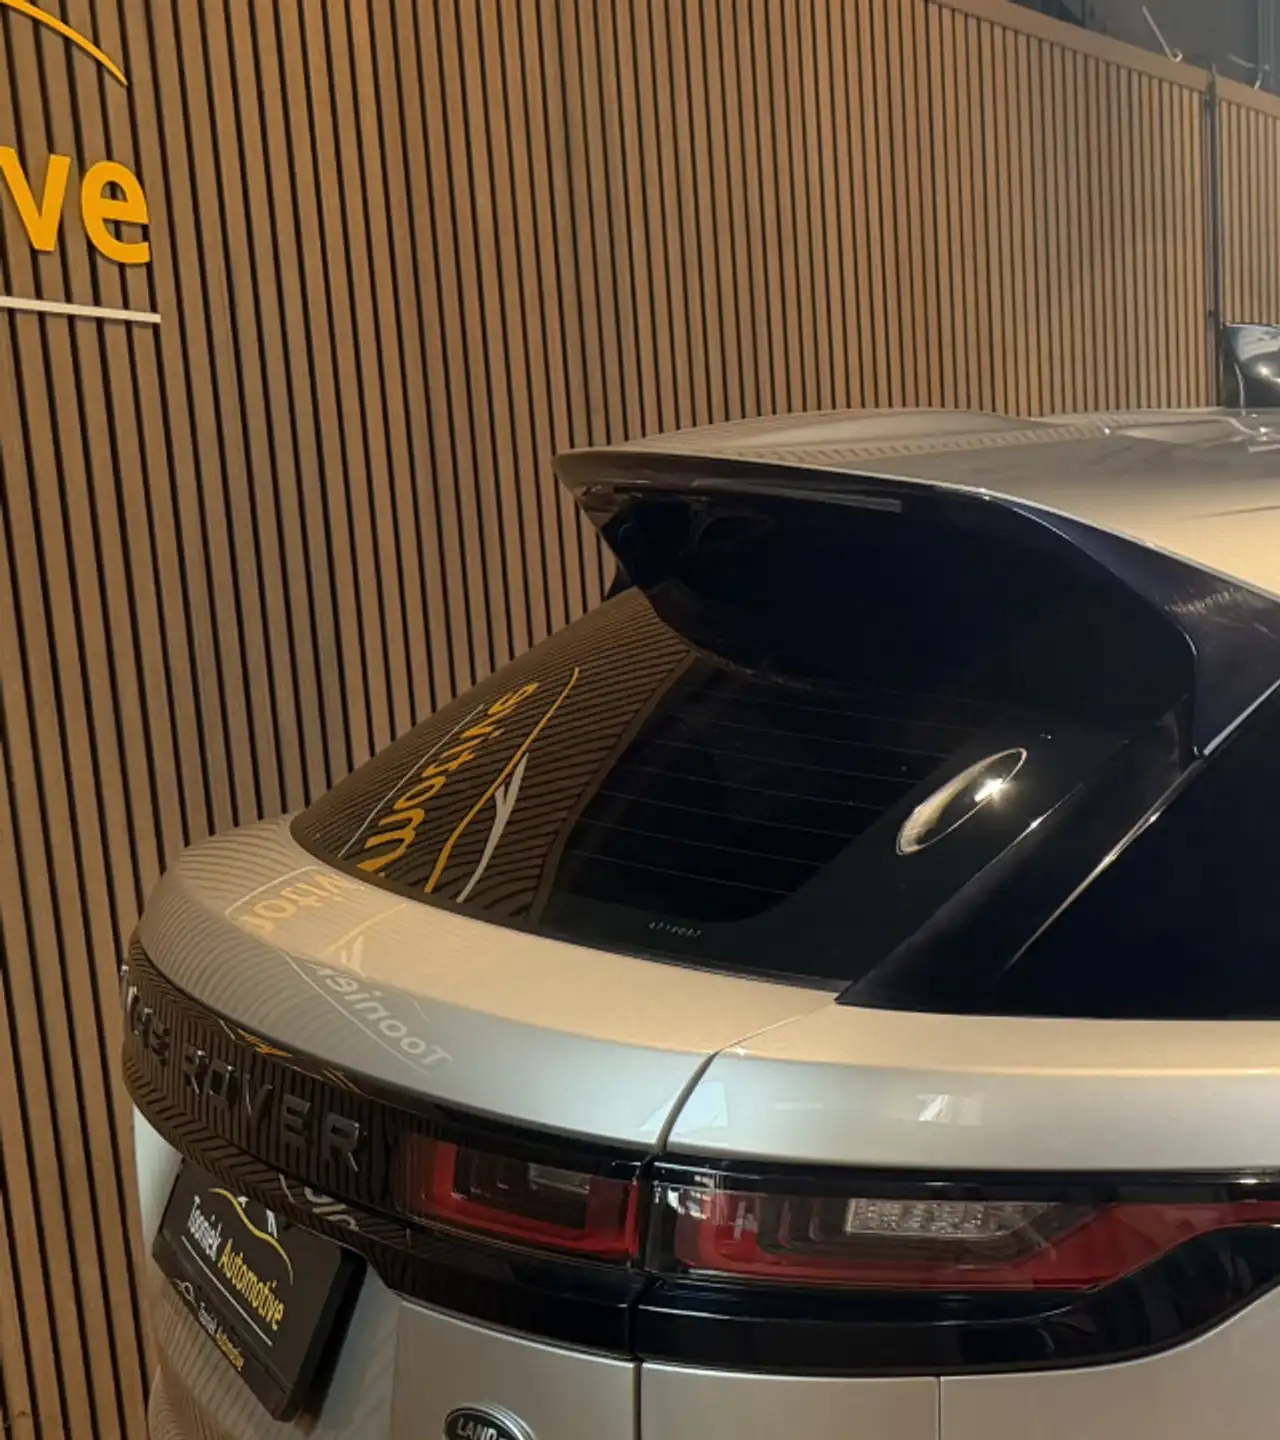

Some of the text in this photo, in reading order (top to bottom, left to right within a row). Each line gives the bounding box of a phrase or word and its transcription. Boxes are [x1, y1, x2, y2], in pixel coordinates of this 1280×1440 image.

[0, 146, 150, 264] ve
[183, 1043, 362, 1174] ROVER
[217, 1237, 285, 1332] Automotive
